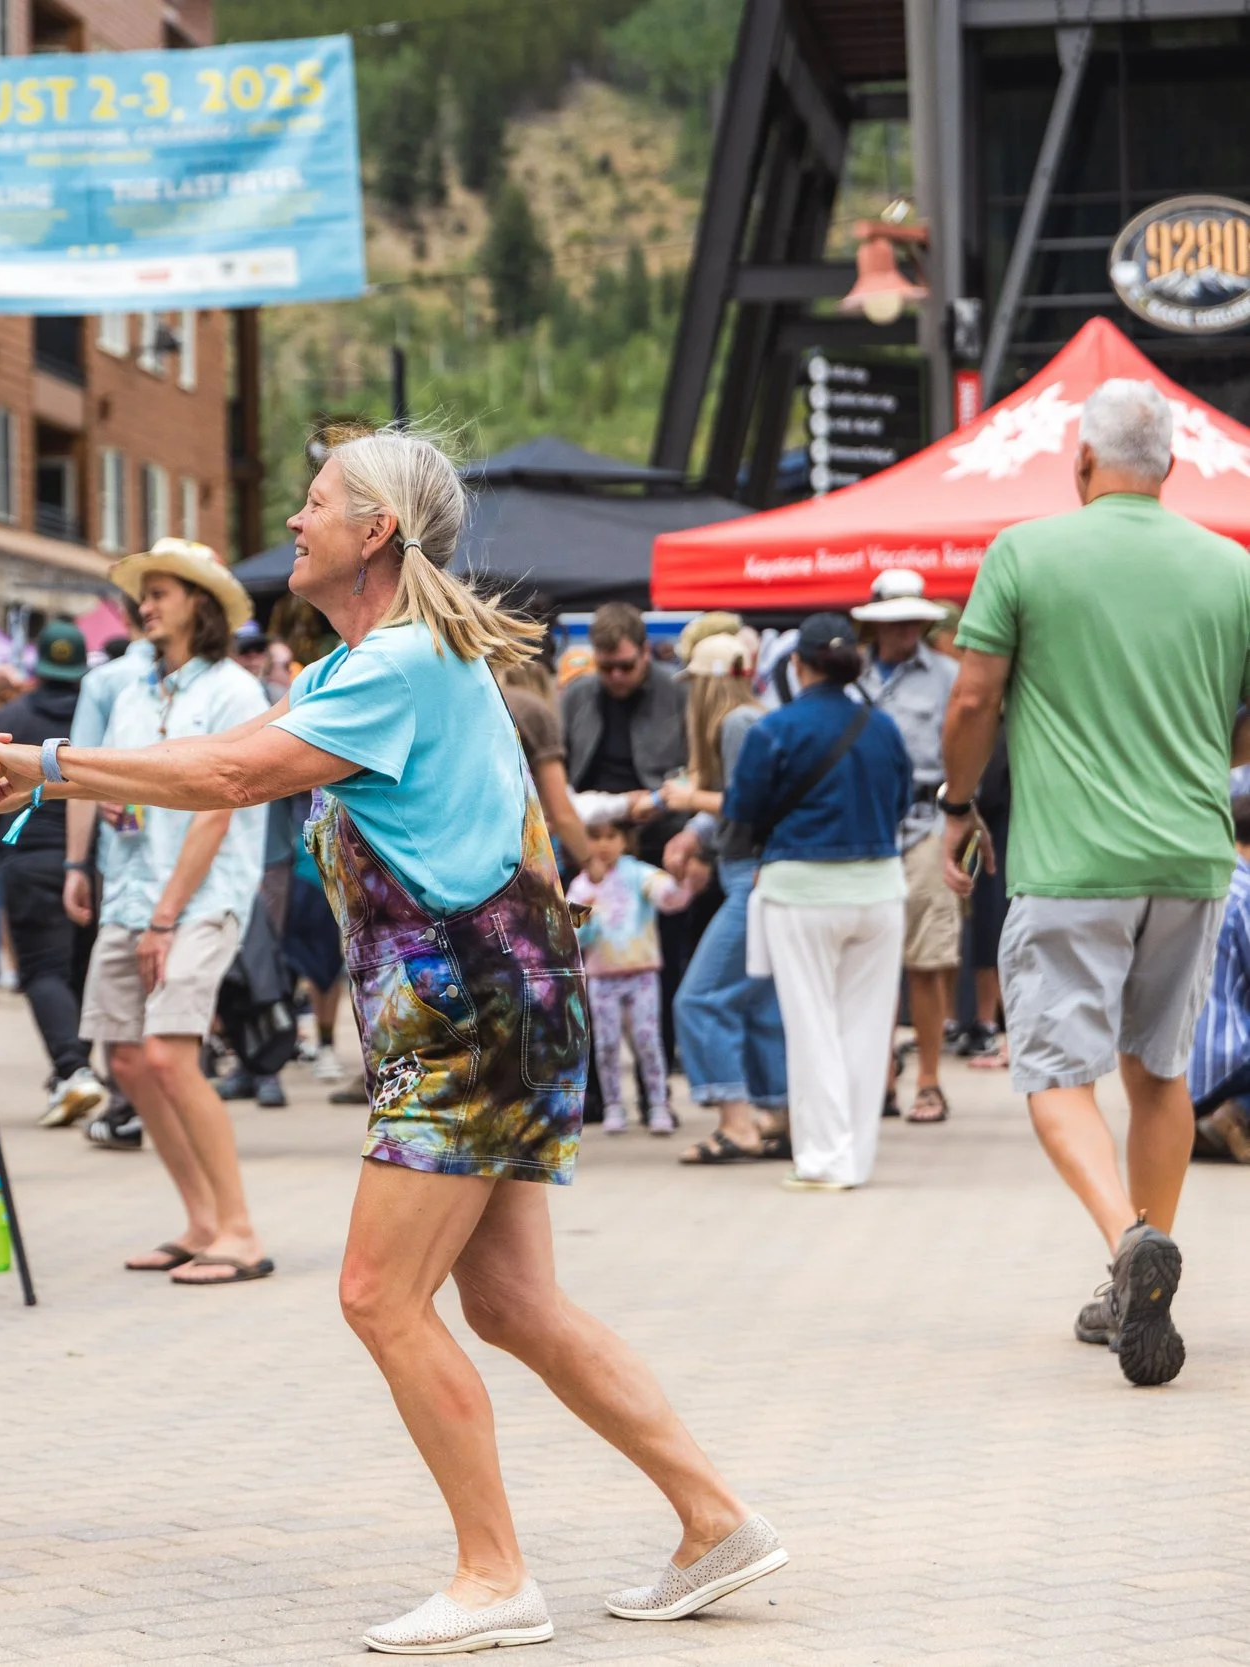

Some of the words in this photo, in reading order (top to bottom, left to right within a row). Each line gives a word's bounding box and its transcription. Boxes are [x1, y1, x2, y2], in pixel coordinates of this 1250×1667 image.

[88, 72, 186, 122] 2-3,
[197, 59, 324, 113] 2025
[1145, 217, 1249, 281] 9280
